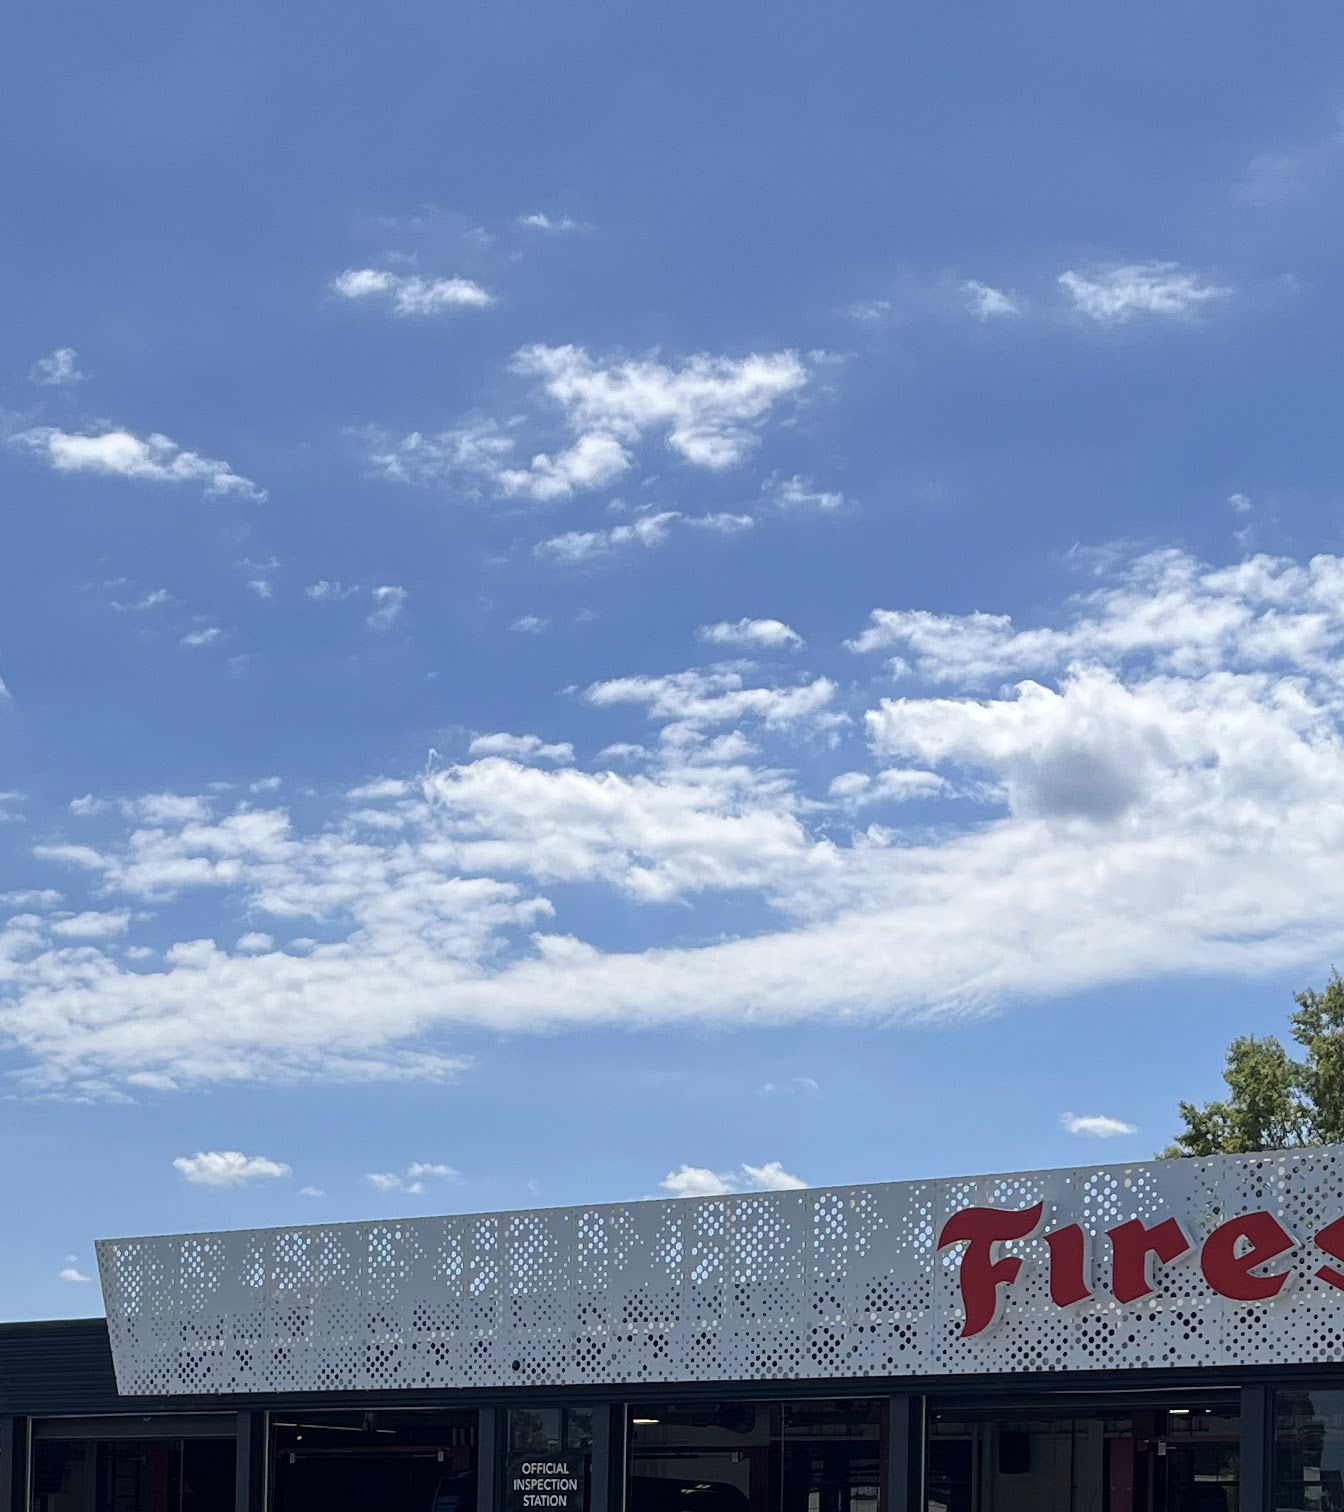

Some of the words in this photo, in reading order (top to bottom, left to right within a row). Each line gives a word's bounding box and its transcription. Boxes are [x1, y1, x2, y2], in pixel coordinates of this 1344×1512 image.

[521, 1462, 570, 1474] OFFICIAL
[513, 1479, 578, 1491] INSPECTION
[523, 1494, 567, 1507] STATION
